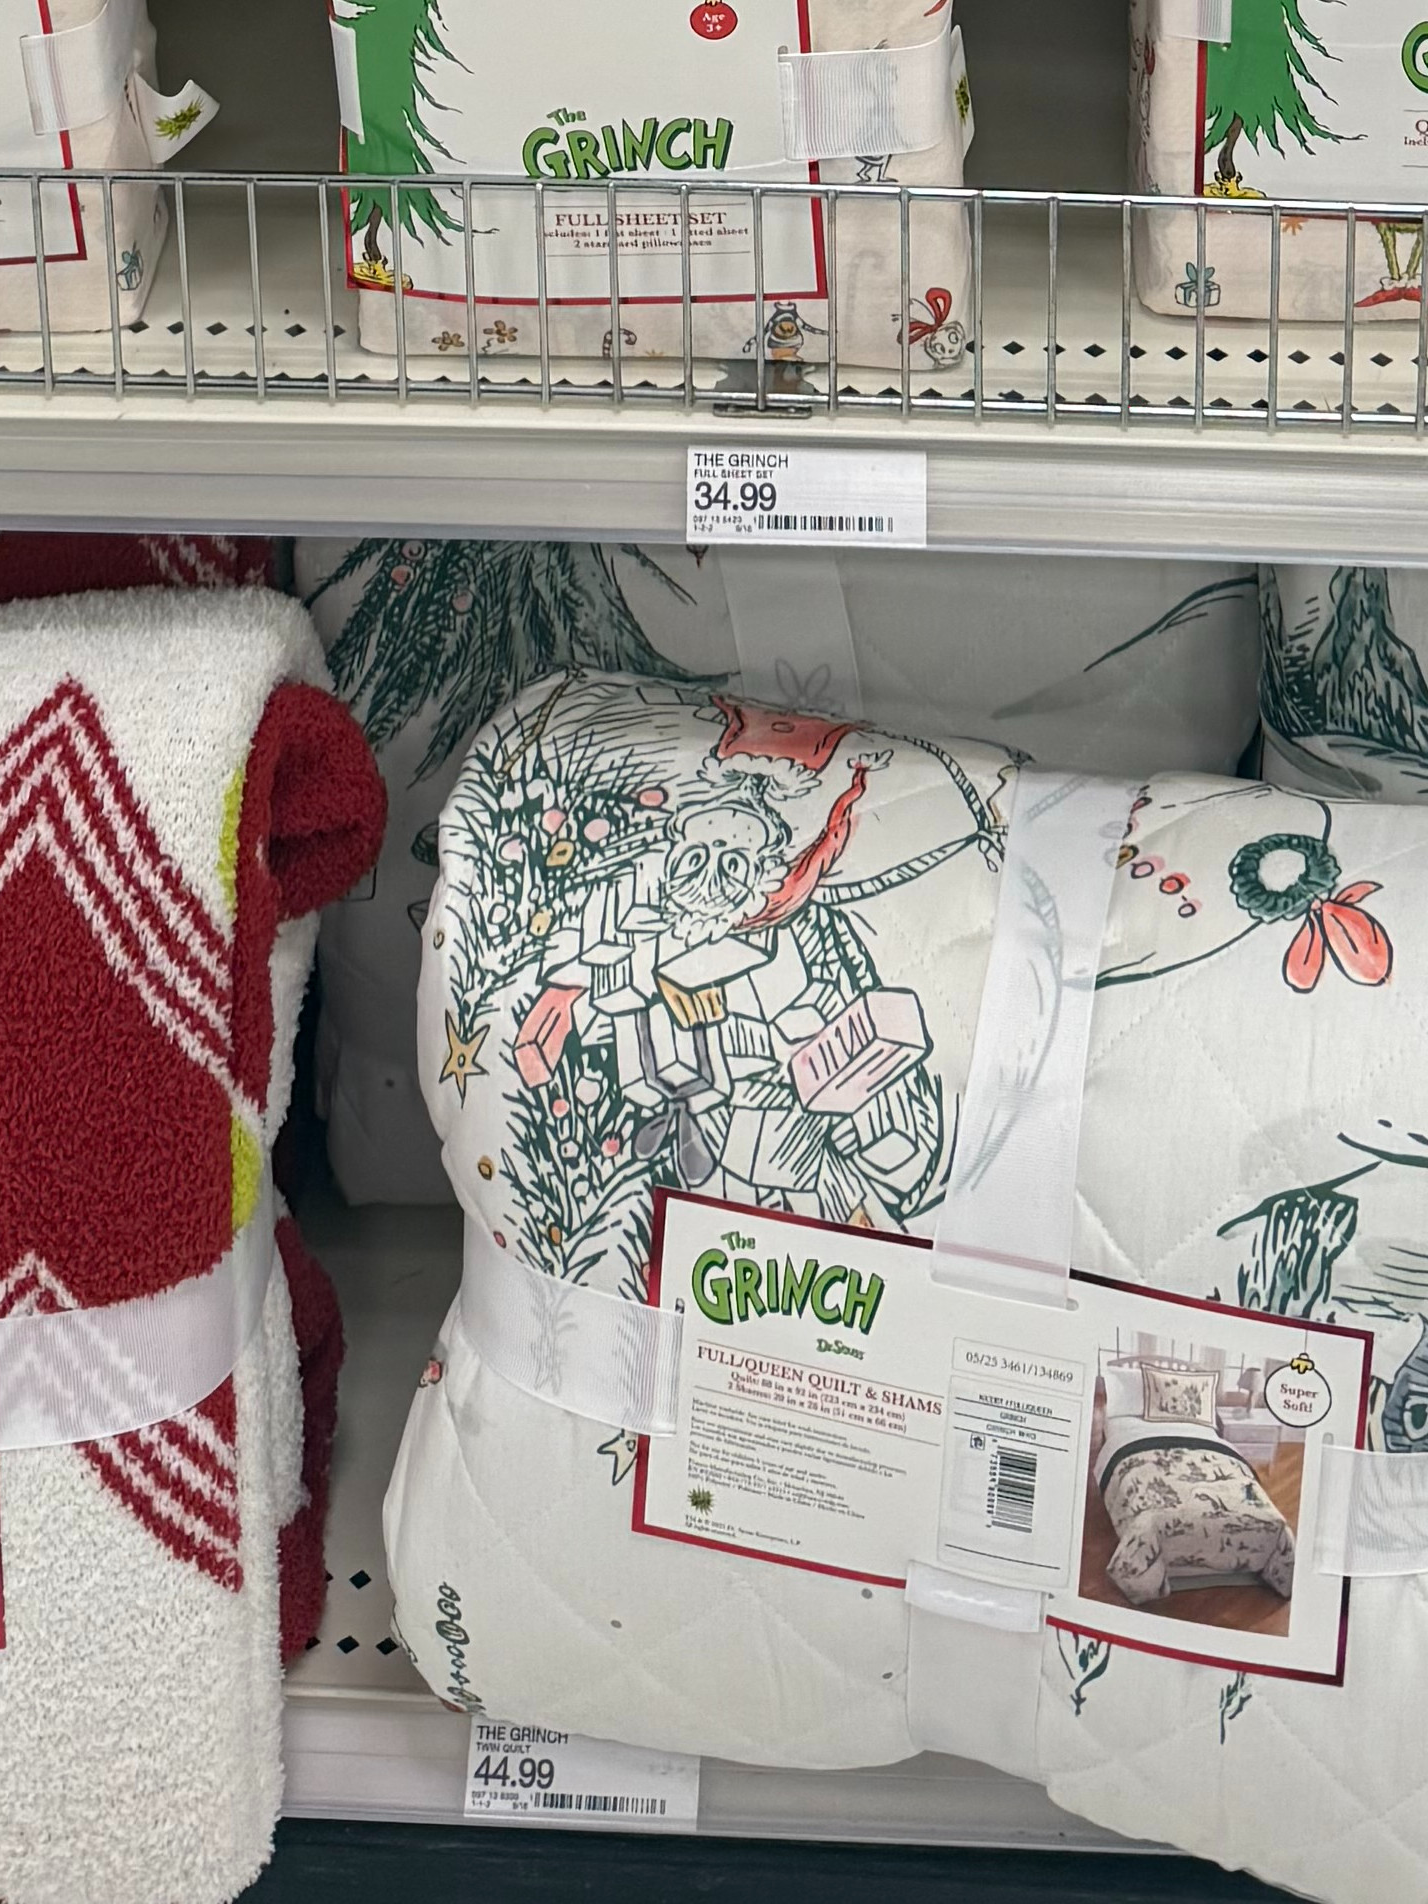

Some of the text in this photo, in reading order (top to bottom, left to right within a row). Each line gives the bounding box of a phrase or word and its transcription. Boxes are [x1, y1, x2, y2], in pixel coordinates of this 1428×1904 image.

[702, 13, 724, 26] Age
[547, 108, 586, 126] The
[522, 118, 734, 179] GRINCH
[556, 212, 727, 226] FULL SHEET SET
[694, 454, 788, 468] THE GRINCH
[694, 469, 774, 479] FULL SHEET SET
[694, 482, 777, 511] 34.99
[721, 1231, 756, 1251] The
[692, 1248, 886, 1335] GRINCH
[966, 1352, 997, 1367] 05/25
[697, 1346, 942, 1415] FULL/QUEEN QUILT & SHAMS
[1280, 1382, 1319, 1402] Super
[1283, 1397, 1314, 1413] Soft!
[476, 1725, 568, 1744] THE GRINCH
[476, 1743, 531, 1754] TWIN QUILT
[474, 1755, 555, 1789] 44.99
